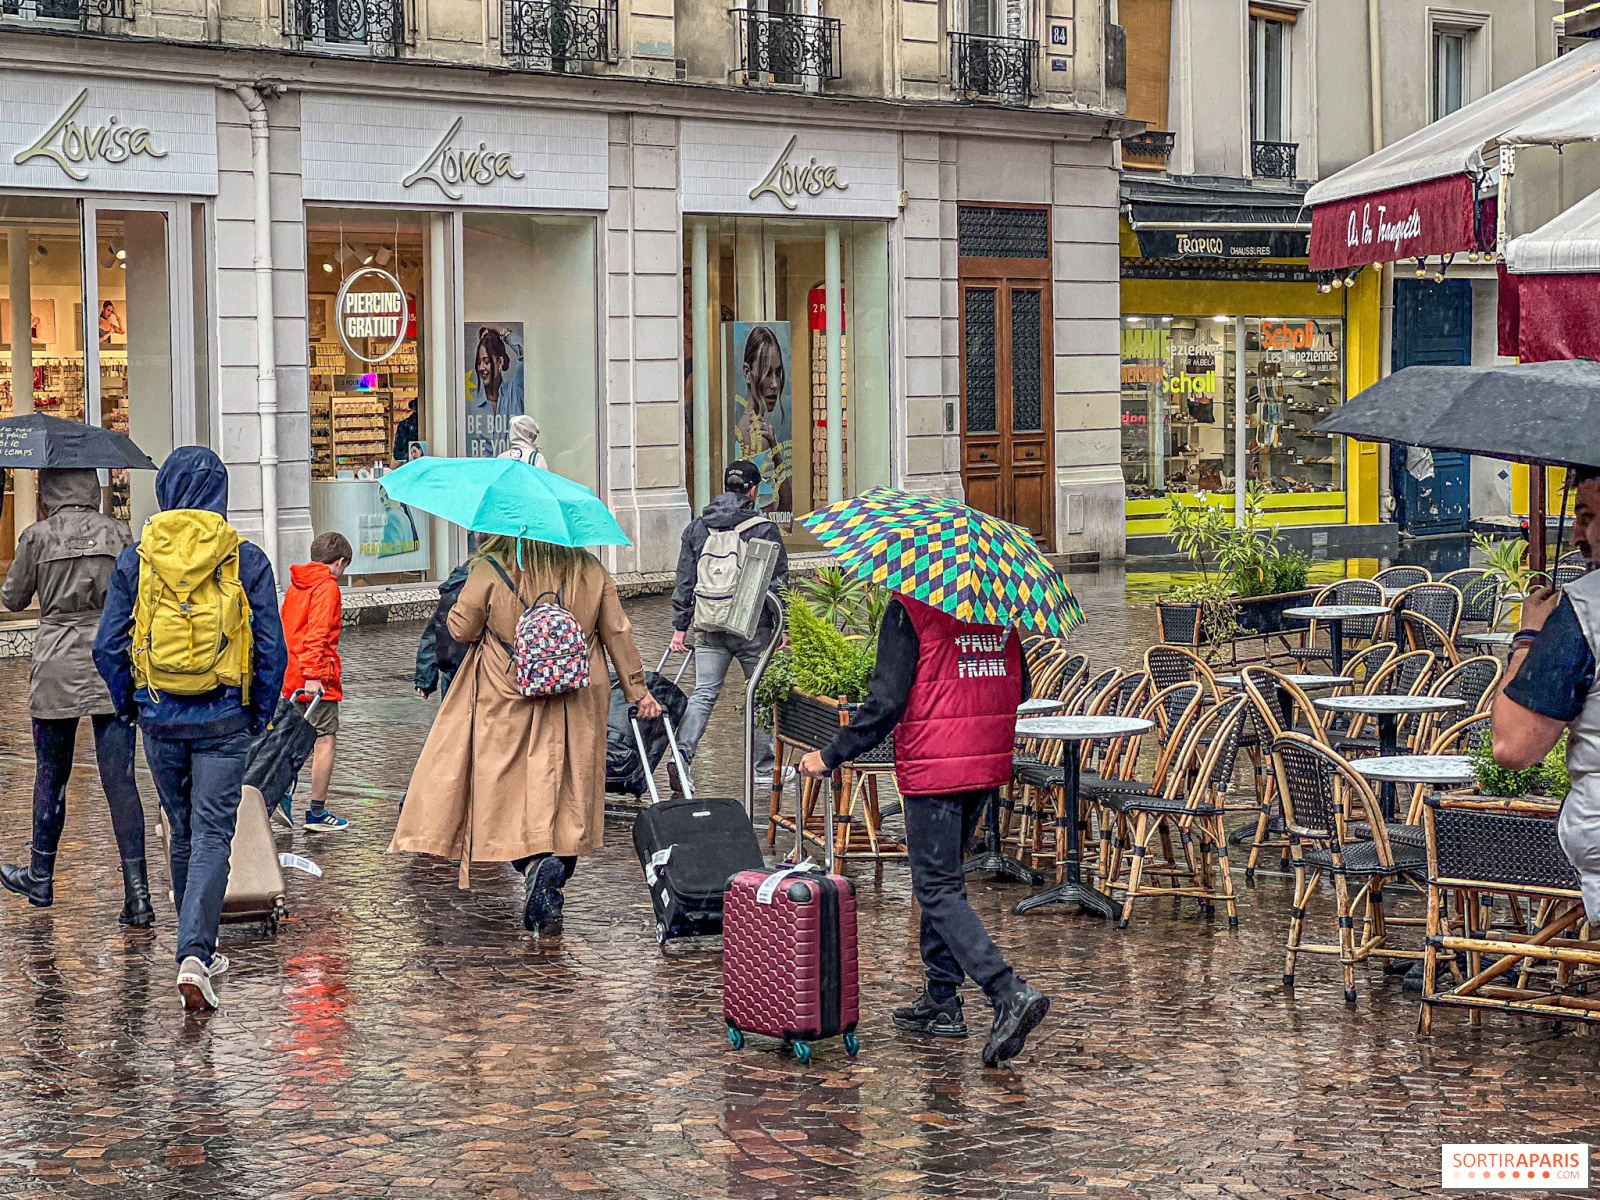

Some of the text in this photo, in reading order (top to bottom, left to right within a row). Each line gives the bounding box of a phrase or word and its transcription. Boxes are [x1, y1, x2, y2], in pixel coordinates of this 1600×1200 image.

[1054, 27, 1066, 43] 84
[14, 87, 168, 181] Lovisa
[402, 116, 526, 200] Lovisa
[749, 134, 849, 210] Lovisa
[1176, 233, 1223, 254] TROPICO
[346, 292, 401, 314] PIERCING
[812, 303, 818, 313] 2
[347, 316, 400, 338] GRATUIT
[1261, 320, 1314, 348] Scholl
[1266, 349, 1281, 364] Les
[1163, 368, 1216, 393] Scholl
[467, 414, 514, 434] BE BOL
[4, 448, 34, 457] temps
[471, 439, 486, 457] BE
[769, 511, 791, 524] STUDIO
[958, 659, 1007, 679] FRANK
